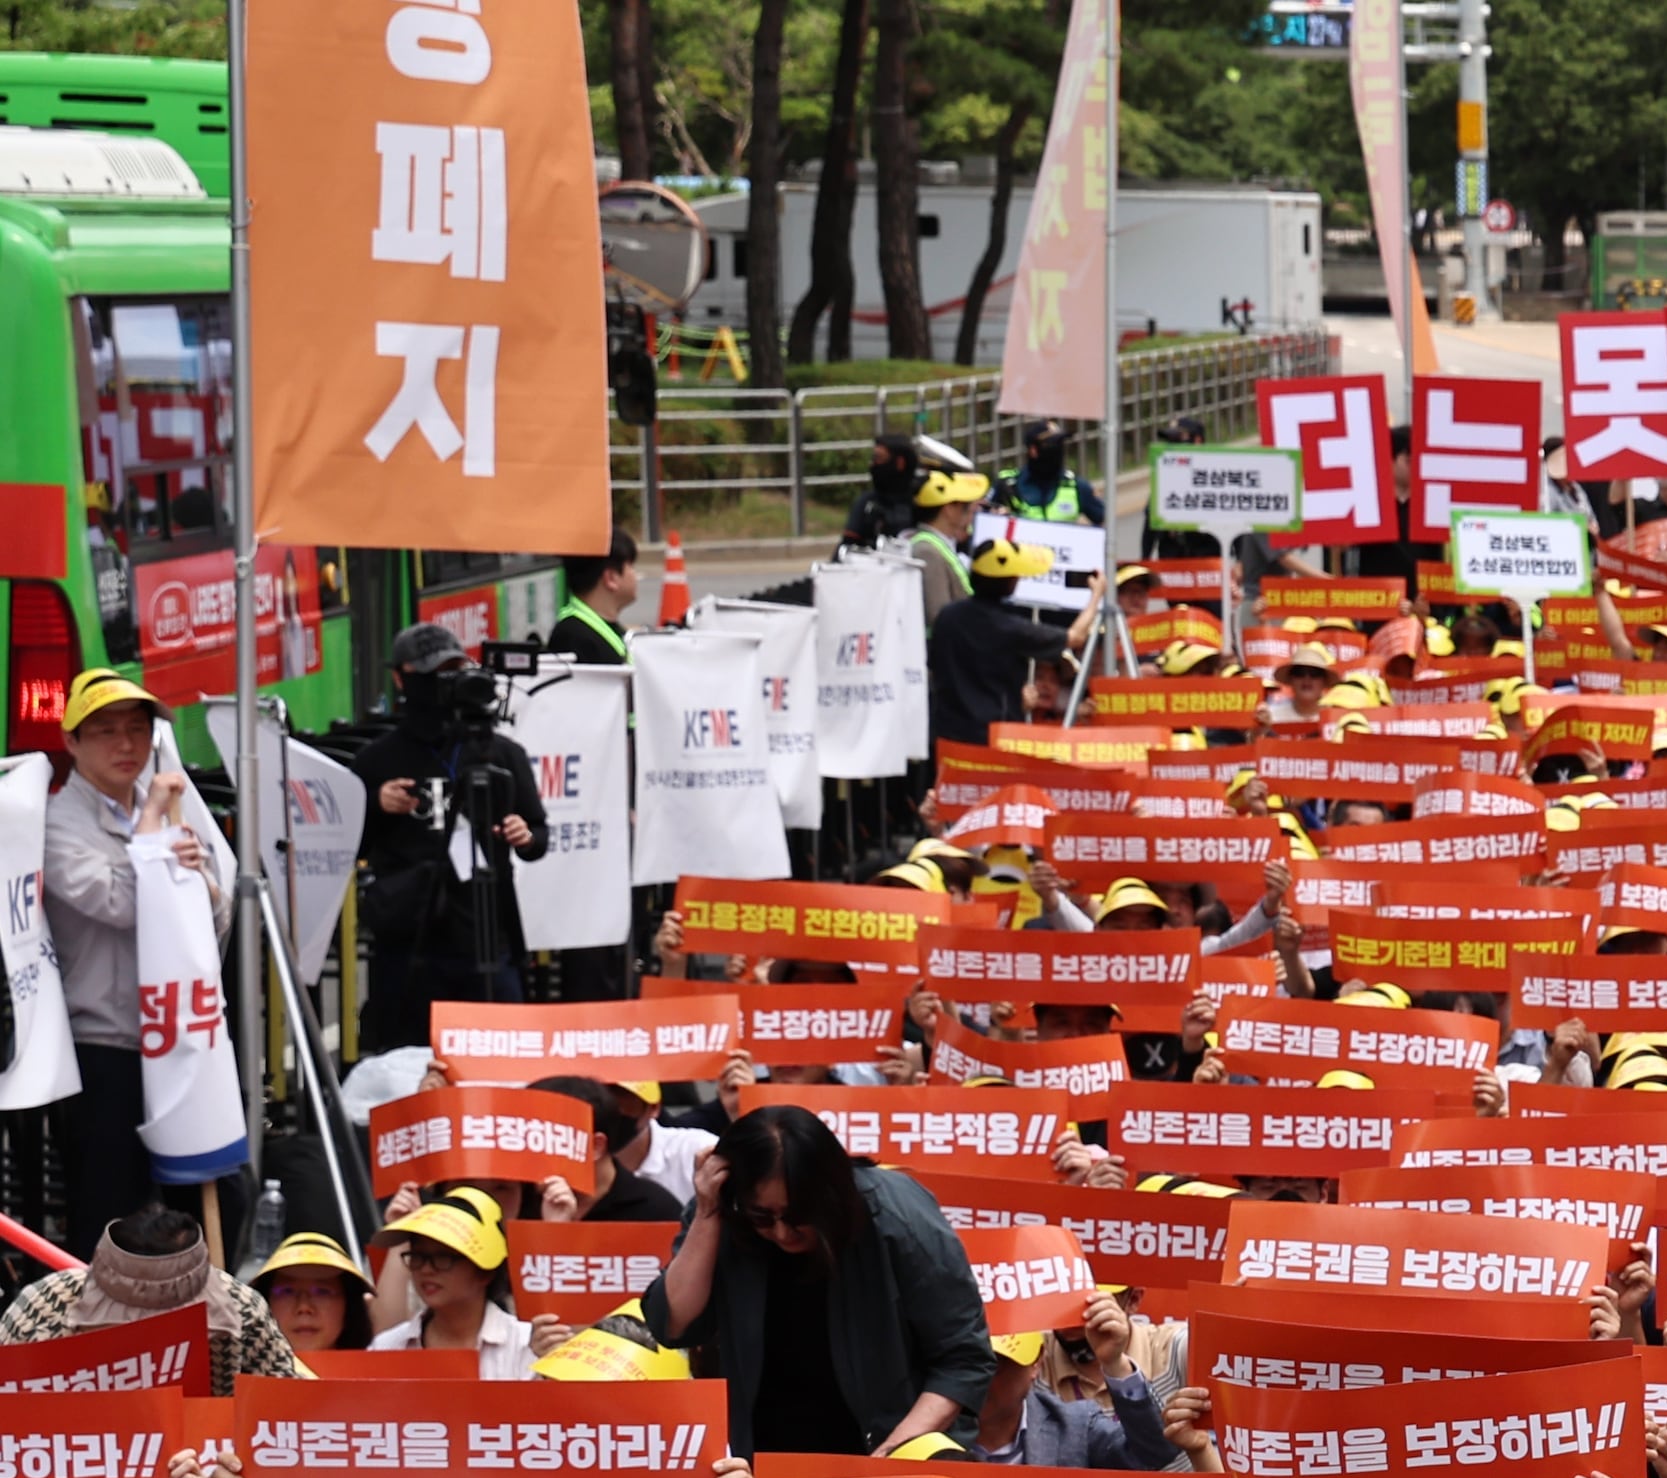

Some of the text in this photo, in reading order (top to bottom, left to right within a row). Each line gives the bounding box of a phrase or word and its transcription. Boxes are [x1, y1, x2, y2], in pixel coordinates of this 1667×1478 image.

[1269, 388, 1531, 533] 더는
[683, 709, 742, 750] KFME
[1552, 844, 1647, 875] 생존권을
[683, 900, 796, 935] 고용정책
[927, 948, 1191, 983] 생존권을 보장하라!!
[441, 1023, 730, 1058] 대형마트 새벽배송 반대!!
[377, 1114, 588, 1168] 생존권을 보장하라!!
[251, 1420, 707, 1471] 생존권을 보장하라!!
